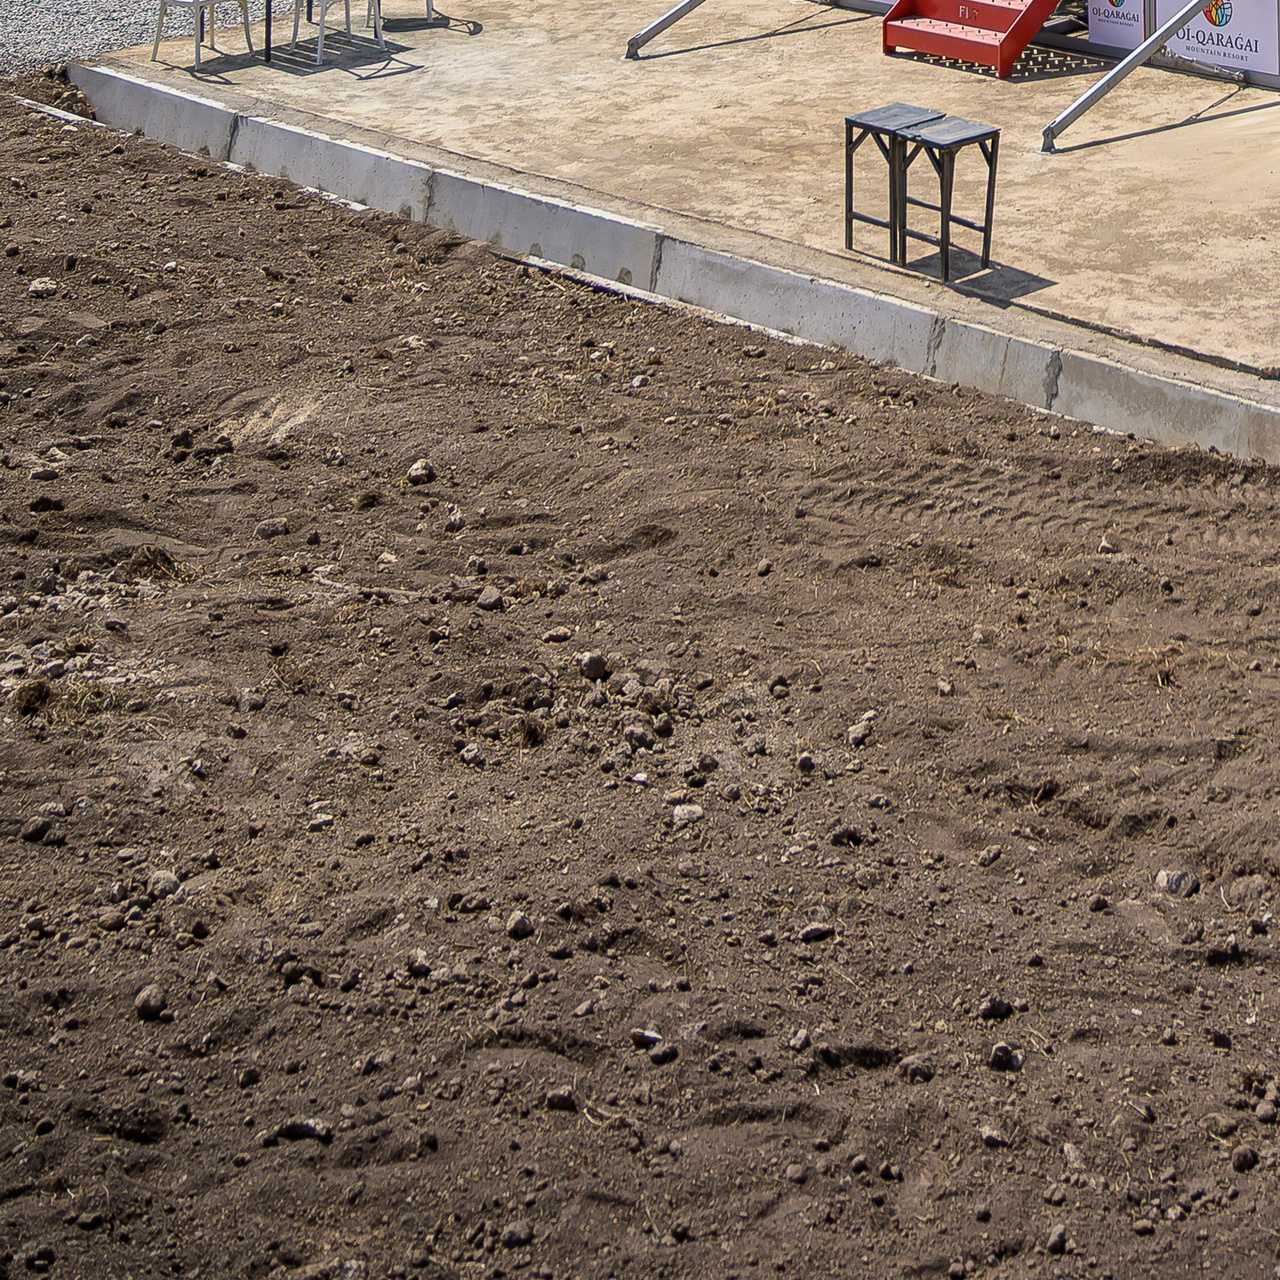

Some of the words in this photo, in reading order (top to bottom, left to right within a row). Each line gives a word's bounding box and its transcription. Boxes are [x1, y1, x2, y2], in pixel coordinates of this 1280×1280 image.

[959, 5, 979, 20] FLY
[1185, 45, 1222, 57] MOUNTAIN
[1222, 51, 1249, 62] RESORT
